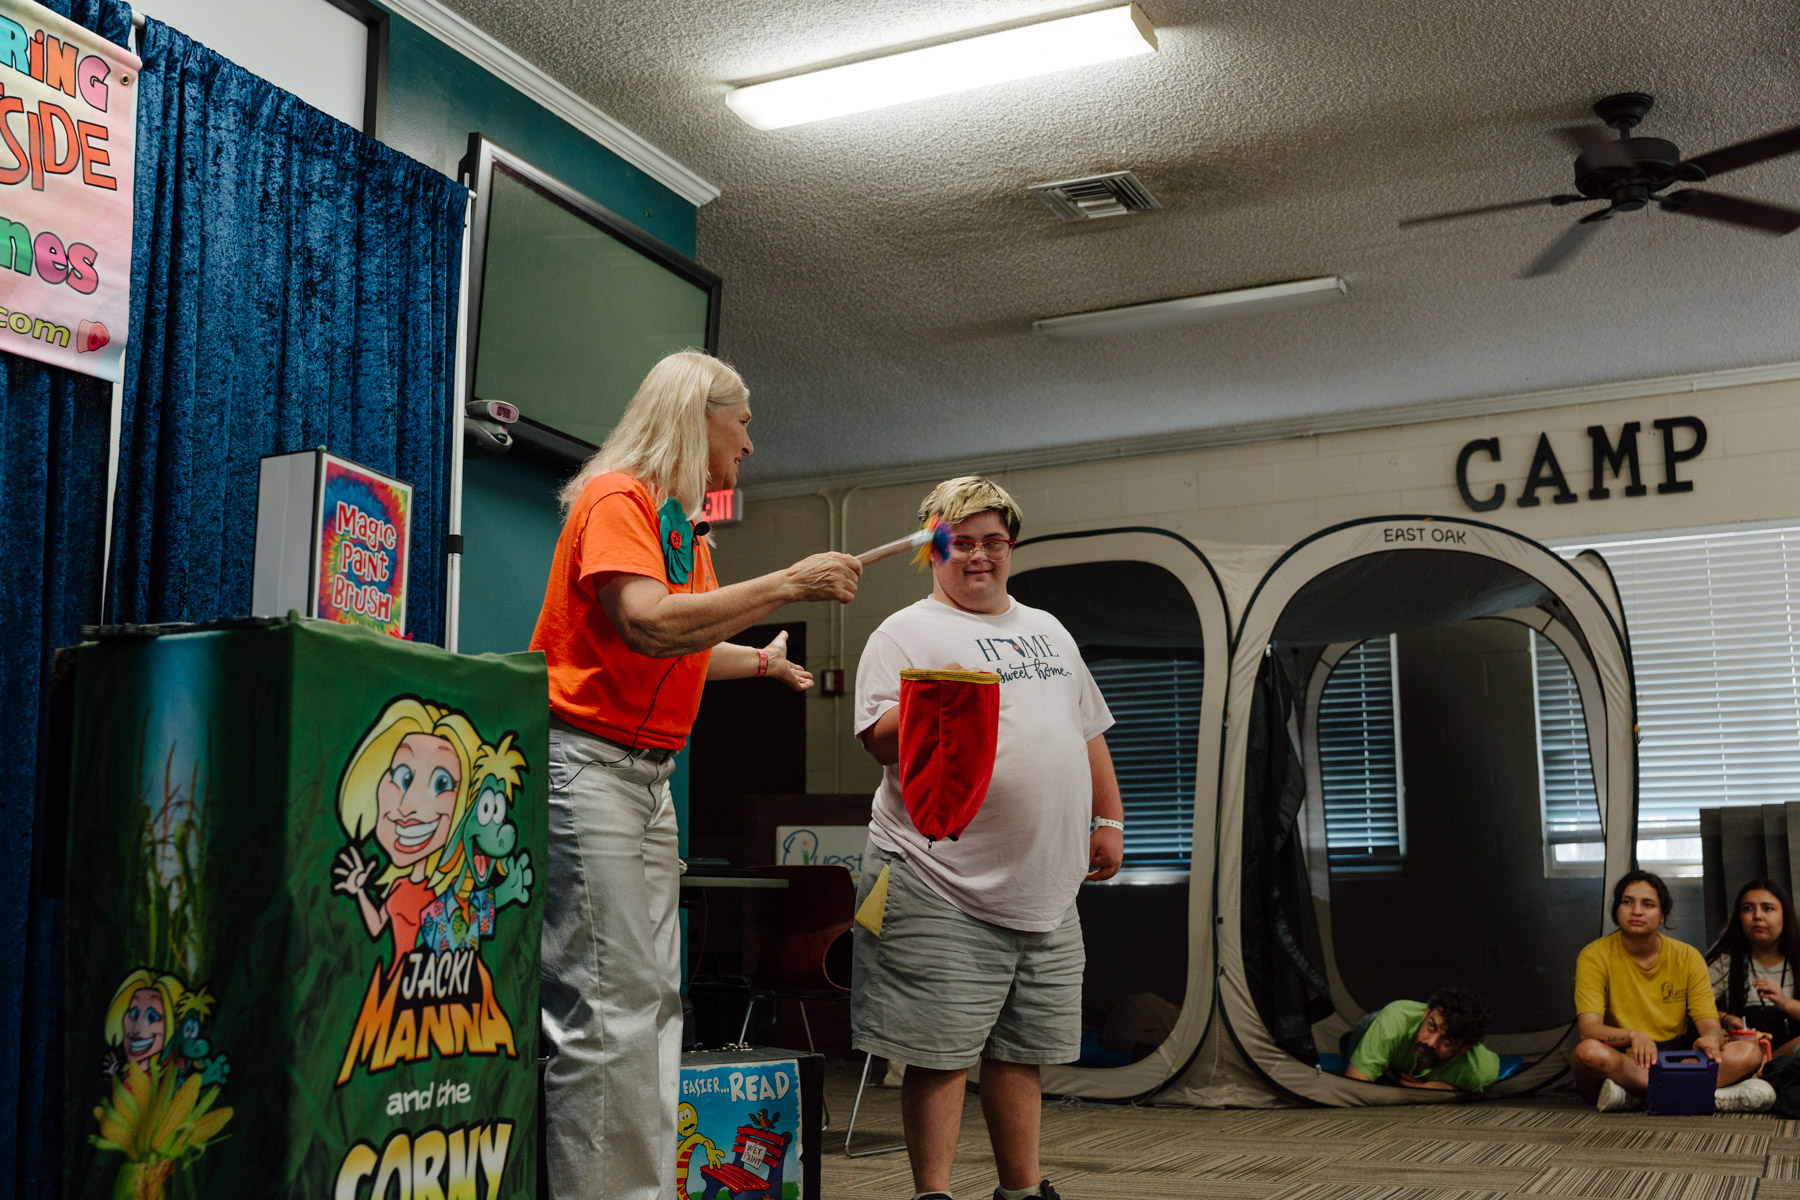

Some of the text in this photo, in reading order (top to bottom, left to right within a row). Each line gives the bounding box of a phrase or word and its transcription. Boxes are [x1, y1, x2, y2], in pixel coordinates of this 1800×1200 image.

[1456, 416, 1708, 512] CAMP
[702, 489, 734, 521] EXIT
[337, 502, 397, 549] Magic
[1384, 528, 1466, 545] EAST OAK
[402, 951, 474, 999] JACKI
[336, 957, 518, 1086] MANNA
[386, 1079, 472, 1116] and the
[743, 1151, 762, 1166] PAINT
[746, 1144, 763, 1156] WET
